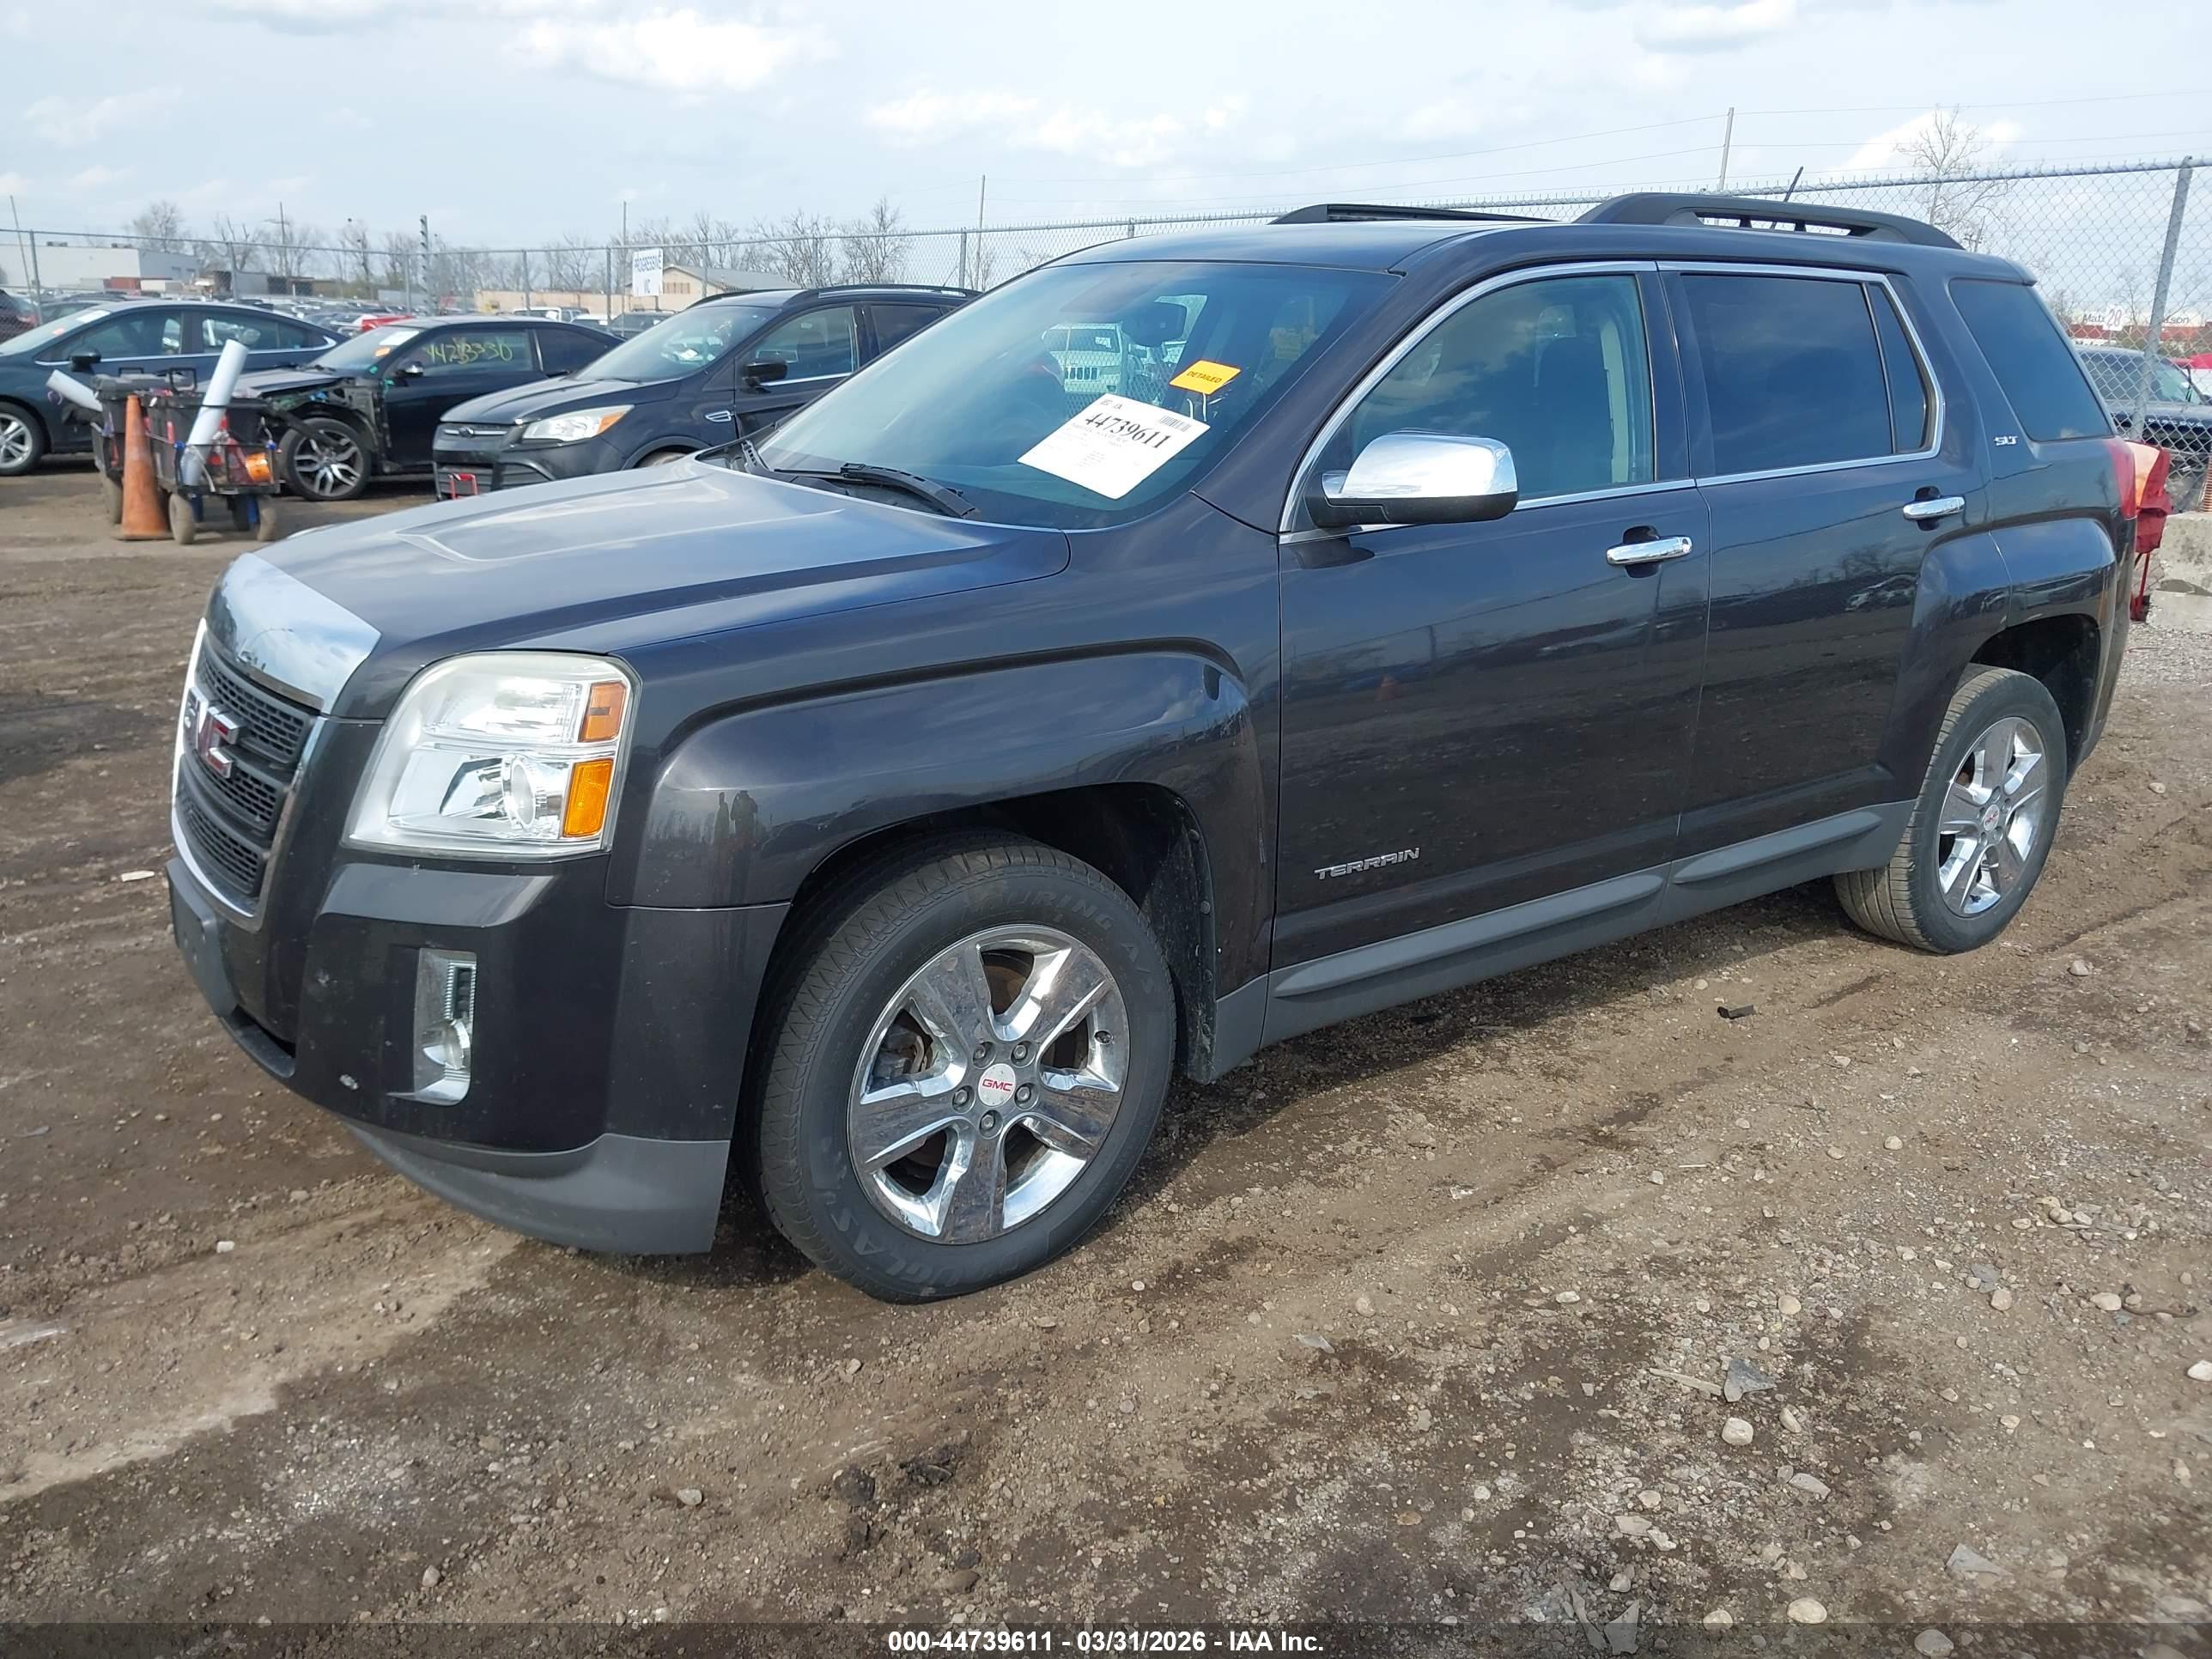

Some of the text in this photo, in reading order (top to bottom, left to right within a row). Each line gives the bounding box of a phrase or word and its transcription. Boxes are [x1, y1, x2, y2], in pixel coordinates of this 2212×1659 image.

[1187, 371, 1223, 384] DETAILED
[1085, 413, 1171, 449] 44739611
[1993, 435, 2018, 447] SLT
[1314, 847, 1419, 880] TERRAIN
[981, 1078, 1013, 1092] GMC
